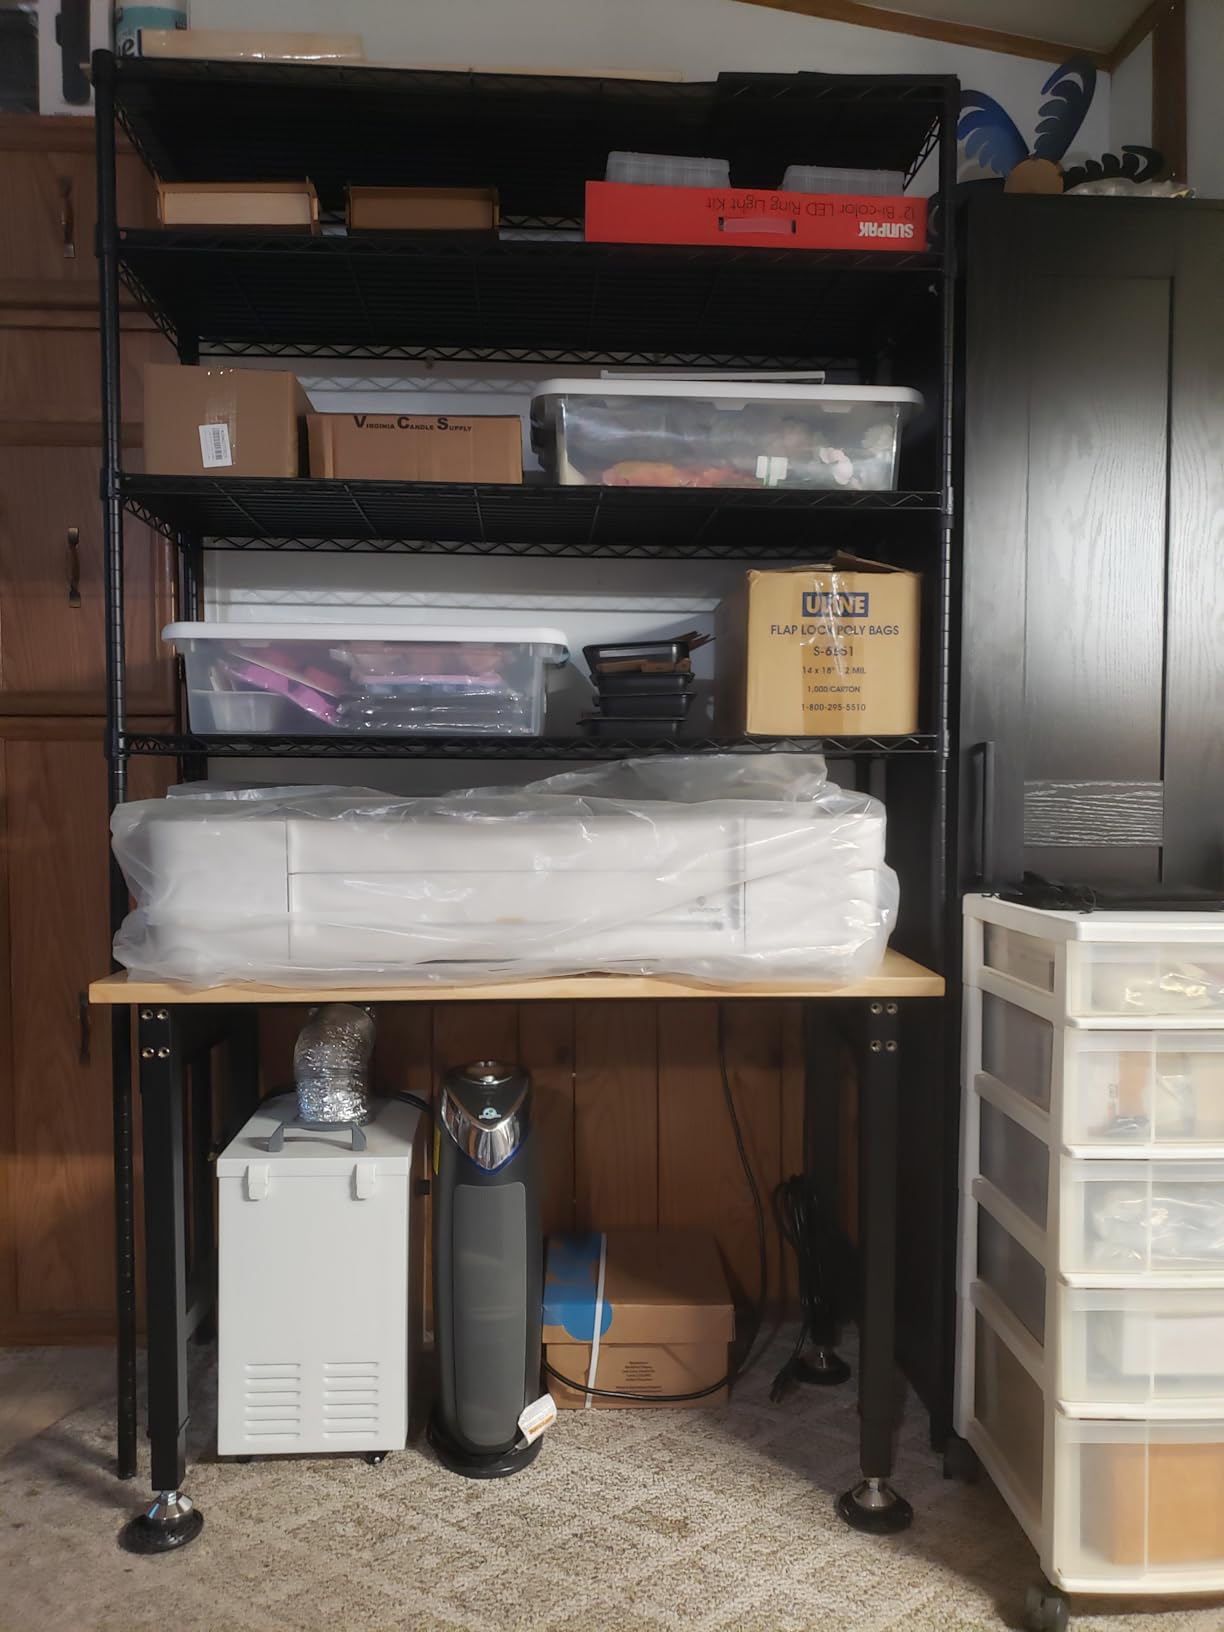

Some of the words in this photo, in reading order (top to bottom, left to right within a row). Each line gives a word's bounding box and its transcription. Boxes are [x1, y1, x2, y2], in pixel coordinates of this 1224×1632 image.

[705, 196, 726, 212] Kit
[730, 195, 766, 215] Light
[769, 197, 801, 217] Ring
[806, 201, 834, 217] LED
[839, 203, 895, 220] Bi-color
[858, 221, 915, 239] SUNPAK
[770, 624, 798, 636] FLAP
[837, 624, 866, 636] POLY
[868, 624, 900, 636] BAGS
[801, 703, 866, 712] 1-800-295-5510
